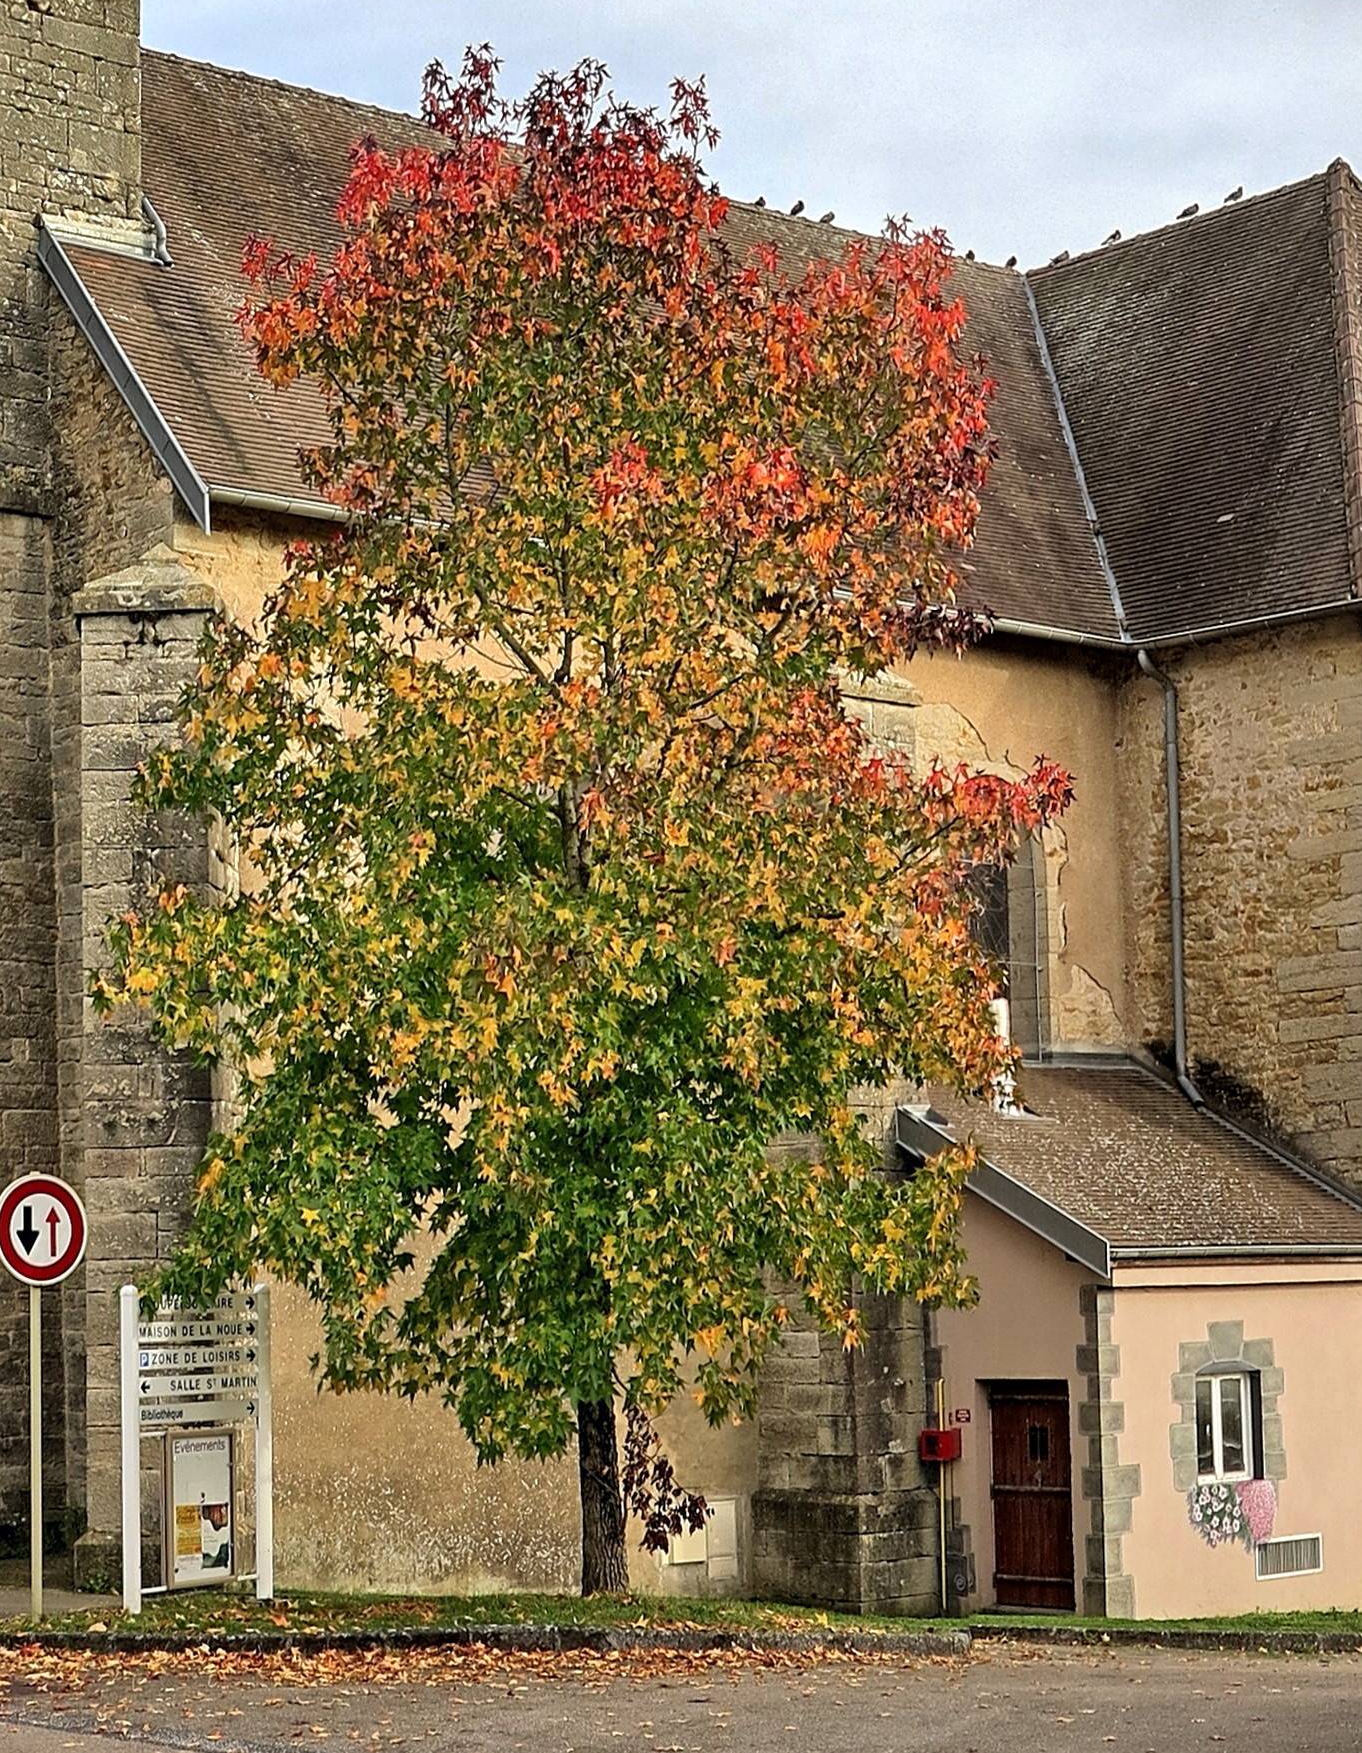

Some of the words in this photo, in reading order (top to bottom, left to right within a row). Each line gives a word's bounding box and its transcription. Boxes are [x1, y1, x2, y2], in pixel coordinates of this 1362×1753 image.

[139, 1325, 177, 1337] MAISON
[182, 1325, 194, 1336] DE
[200, 1324, 212, 1336] LA
[217, 1323, 243, 1335] NOUE
[152, 1351, 179, 1365] ZONE
[185, 1351, 198, 1363] DE
[203, 1350, 241, 1362] LOISIRS
[170, 1380, 201, 1391] SALLE
[221, 1376, 257, 1388] MARTIN
[141, 1409, 184, 1421] Bibliothèque
